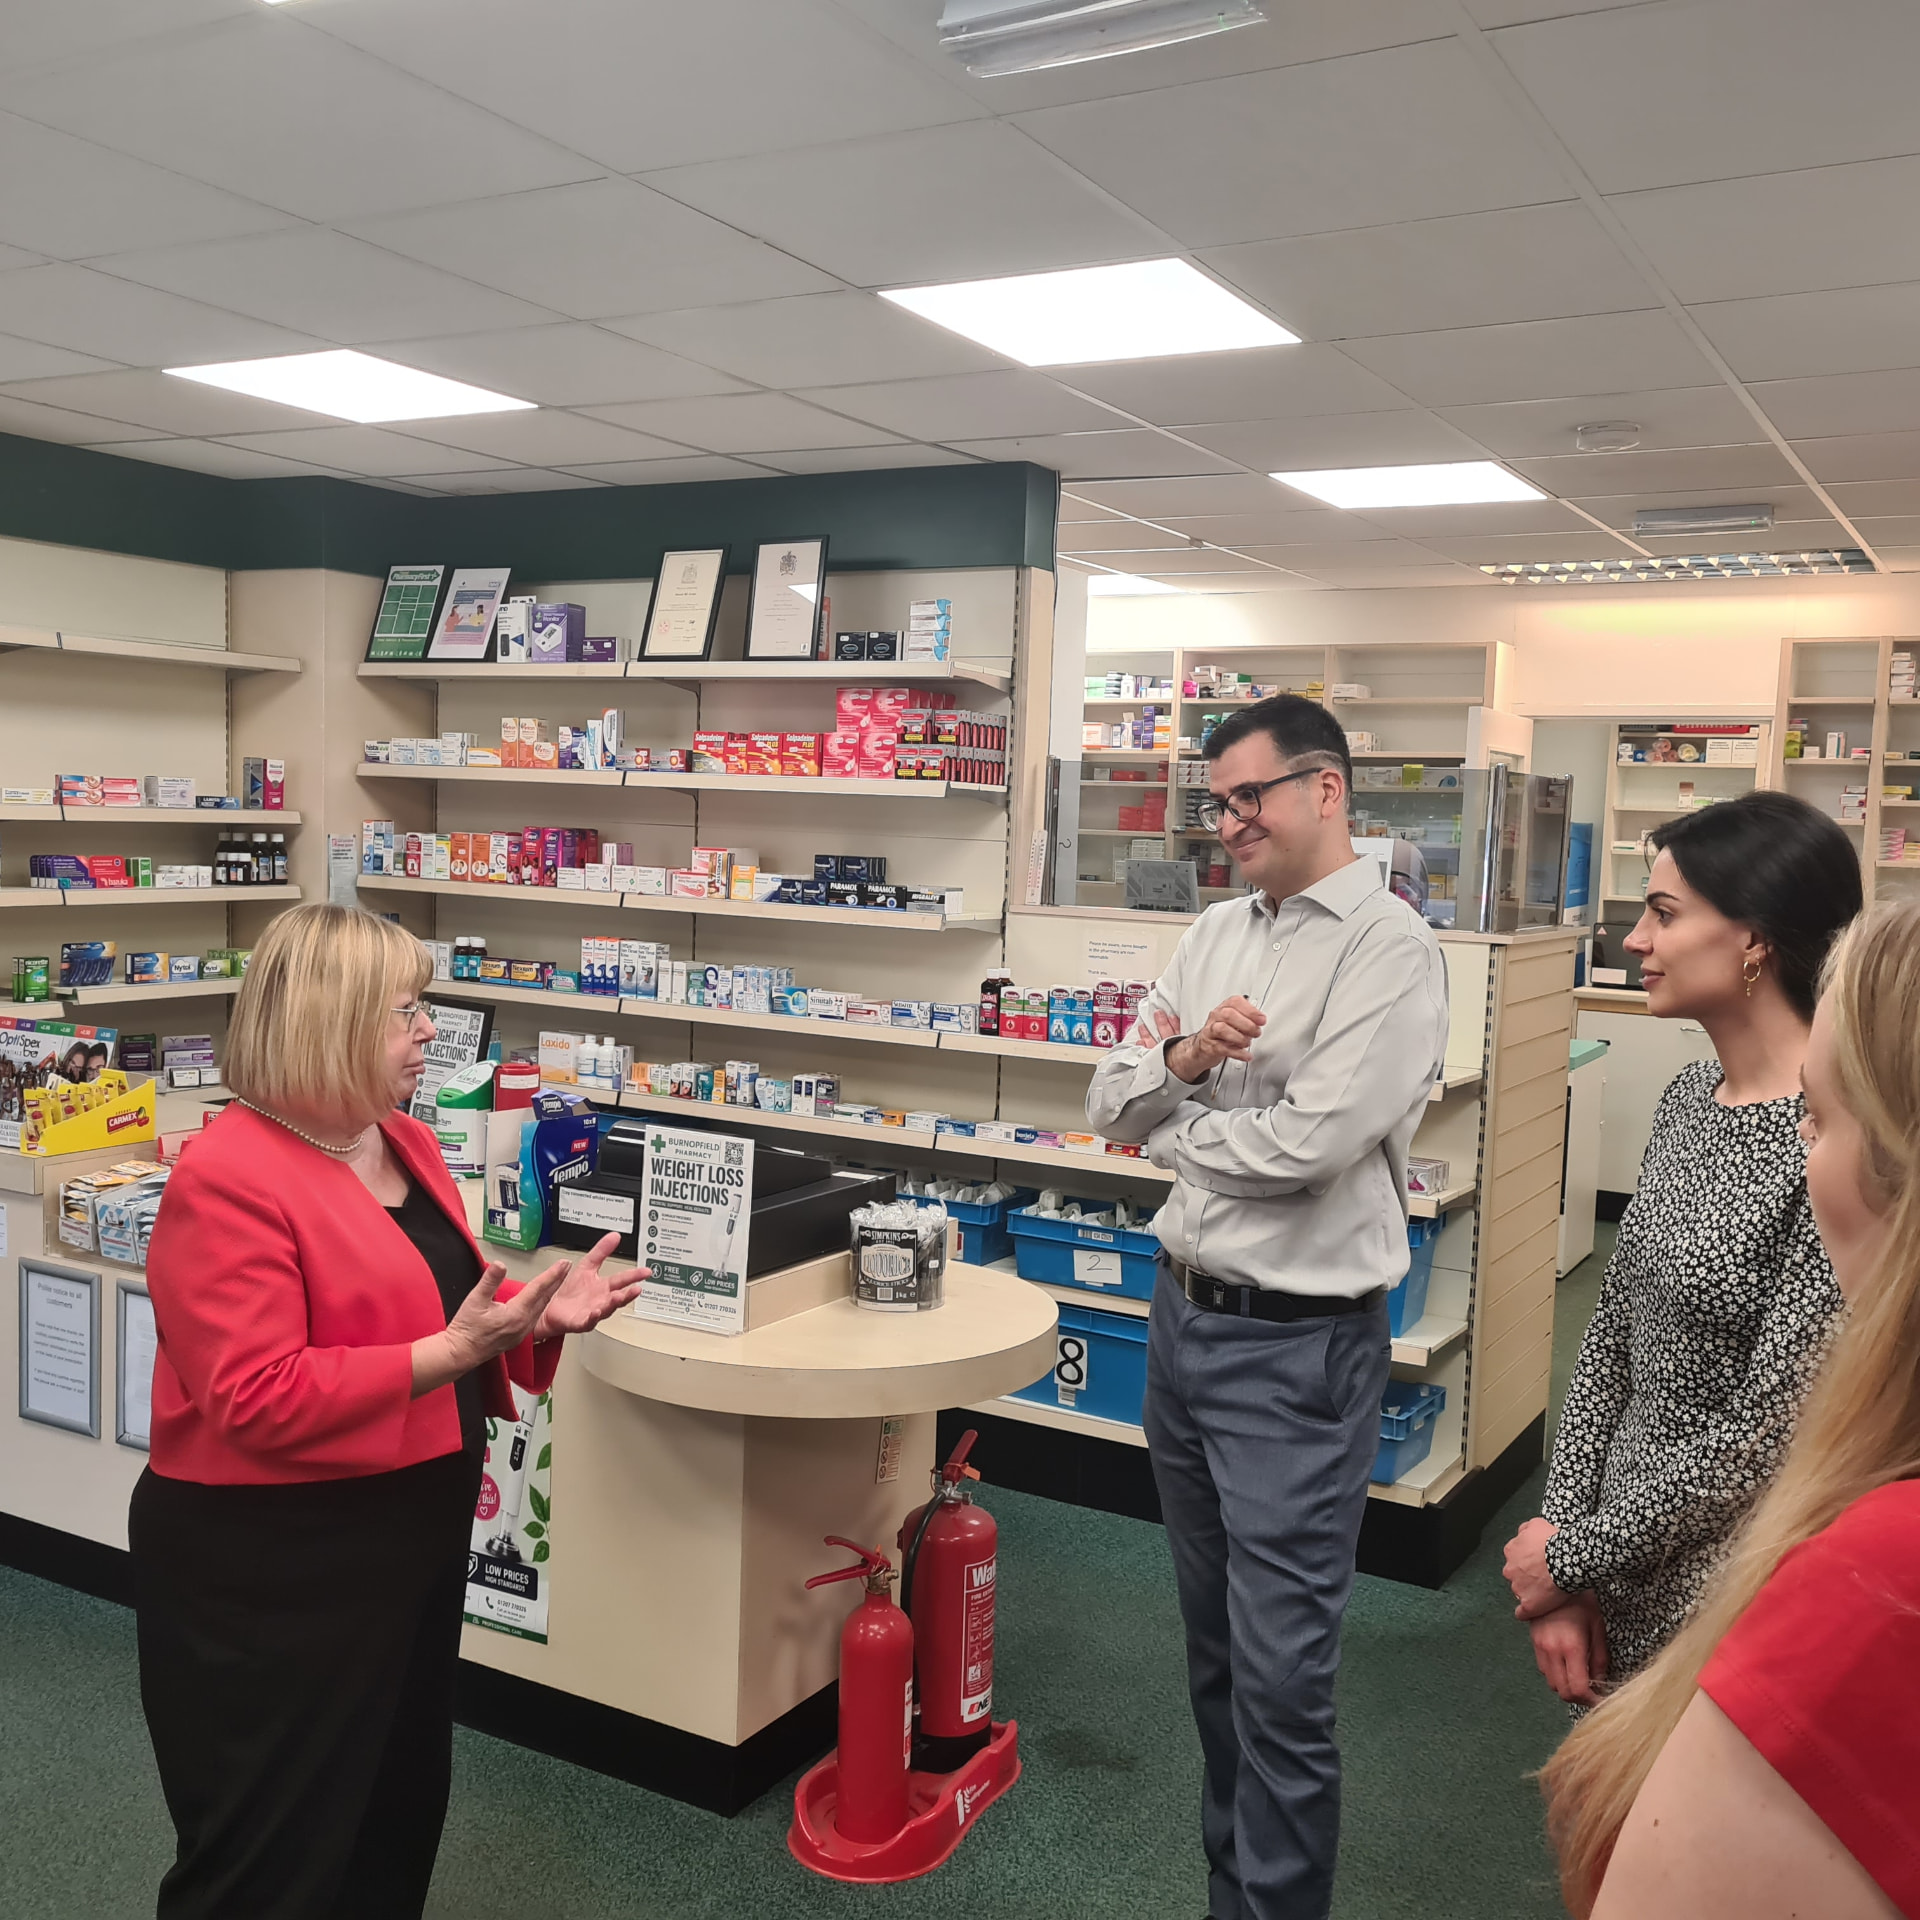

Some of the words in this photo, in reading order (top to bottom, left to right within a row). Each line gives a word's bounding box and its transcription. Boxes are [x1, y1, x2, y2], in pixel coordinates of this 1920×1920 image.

[695, 733, 725, 742] Solpadeine
[751, 733, 779, 742] Solpadeine
[786, 734, 815, 743] Solpadeine
[830, 881, 858, 891] PARAMOL
[867, 884, 896, 894] PARAMOL
[512, 964, 534, 972] Nexium
[1052, 990, 1069, 998] Benylin
[1097, 984, 1119, 994] Benylin
[1127, 986, 1148, 996] Benylin
[809, 996, 833, 1005] Sinutab
[1073, 992, 1091, 1000] Benylin
[1095, 994, 1119, 1002] CHESTY
[434, 1028, 457, 1044] EIGHT
[458, 1031, 478, 1048] LOSS
[541, 1035, 570, 1050] Laxido
[423, 1041, 468, 1062] INJECTIONS
[540, 1097, 565, 1113] Tempo
[108, 1112, 137, 1127] CARMEX
[1016, 1132, 1034, 1140] bonjela
[573, 1141, 587, 1149] NEW
[668, 1137, 720, 1151] BURNOPFIELD
[675, 1148, 712, 1159] PHARMACY
[549, 1156, 592, 1184] Tempo
[651, 1157, 705, 1182] WEIGHT
[708, 1165, 744, 1188] LOSS
[650, 1178, 729, 1206] INJECTIONS
[871, 1230, 901, 1242] SIMPKINS
[1087, 1254, 1112, 1271] 2
[664, 1265, 680, 1274] FREE
[704, 1278, 716, 1286] LOW
[716, 1280, 735, 1289] PRICES
[53, 1287, 68, 1297] notice
[671, 1287, 696, 1298] CONTACT
[697, 1292, 705, 1300] US
[895, 1291, 907, 1299] 1kg
[1056, 1338, 1084, 1385] 8
[482, 1492, 497, 1504] this!
[485, 1563, 502, 1577] LOW
[503, 1568, 529, 1585] PRICES
[972, 1559, 996, 1588] Wat
[484, 1575, 497, 1584] HIGH
[497, 1579, 526, 1593] STANDARDS
[497, 1599, 511, 1608] 01207
